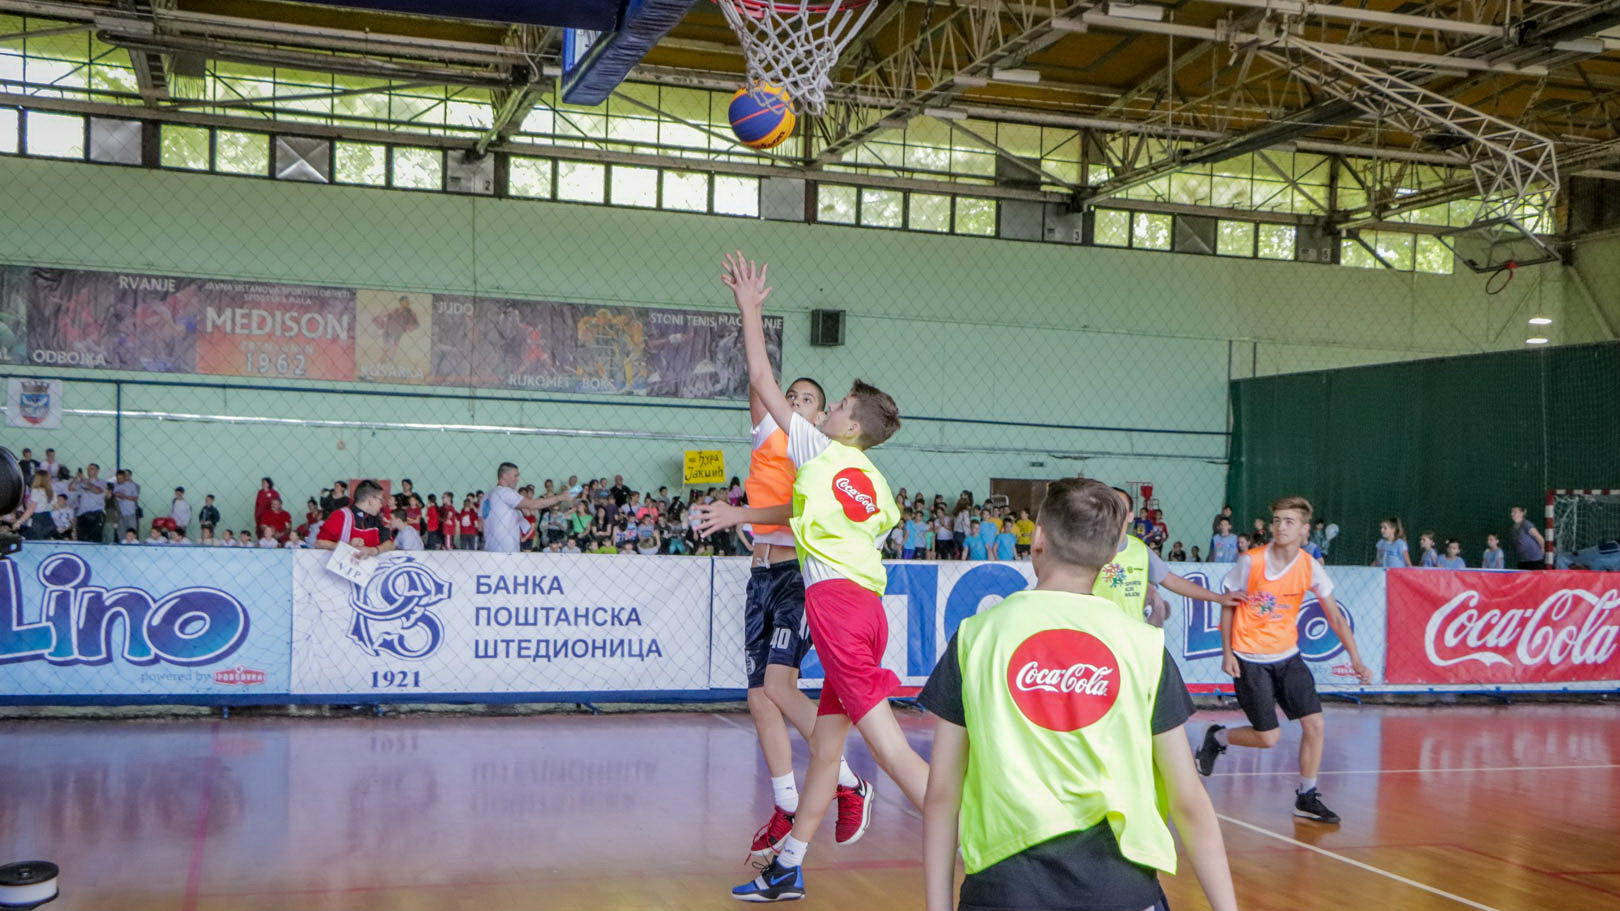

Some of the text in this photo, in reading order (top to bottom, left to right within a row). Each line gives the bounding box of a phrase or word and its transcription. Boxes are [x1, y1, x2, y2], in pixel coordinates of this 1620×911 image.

[118, 275, 177, 292] RVANJE
[437, 301, 474, 316] JUDO
[650, 312, 684, 325] STONI
[205, 306, 349, 340] MEDISON
[33, 350, 106, 366] ODBOJKA
[246, 352, 306, 376] 1962
[509, 374, 569, 388] RUKOMET
[835, 477, 876, 514] Coca-Cola
[475, 575, 564, 595] БАНКА
[0, 552, 250, 667] Lino
[475, 607, 641, 627] ПОШТАНСКА
[1424, 588, 1620, 667] Coca-Cola
[475, 639, 662, 662] ШТЕДИОНИЦА
[140, 671, 192, 684] powered
[195, 670, 212, 684] by
[371, 670, 421, 688] 1921
[1016, 661, 1113, 696] Coca-Cola
